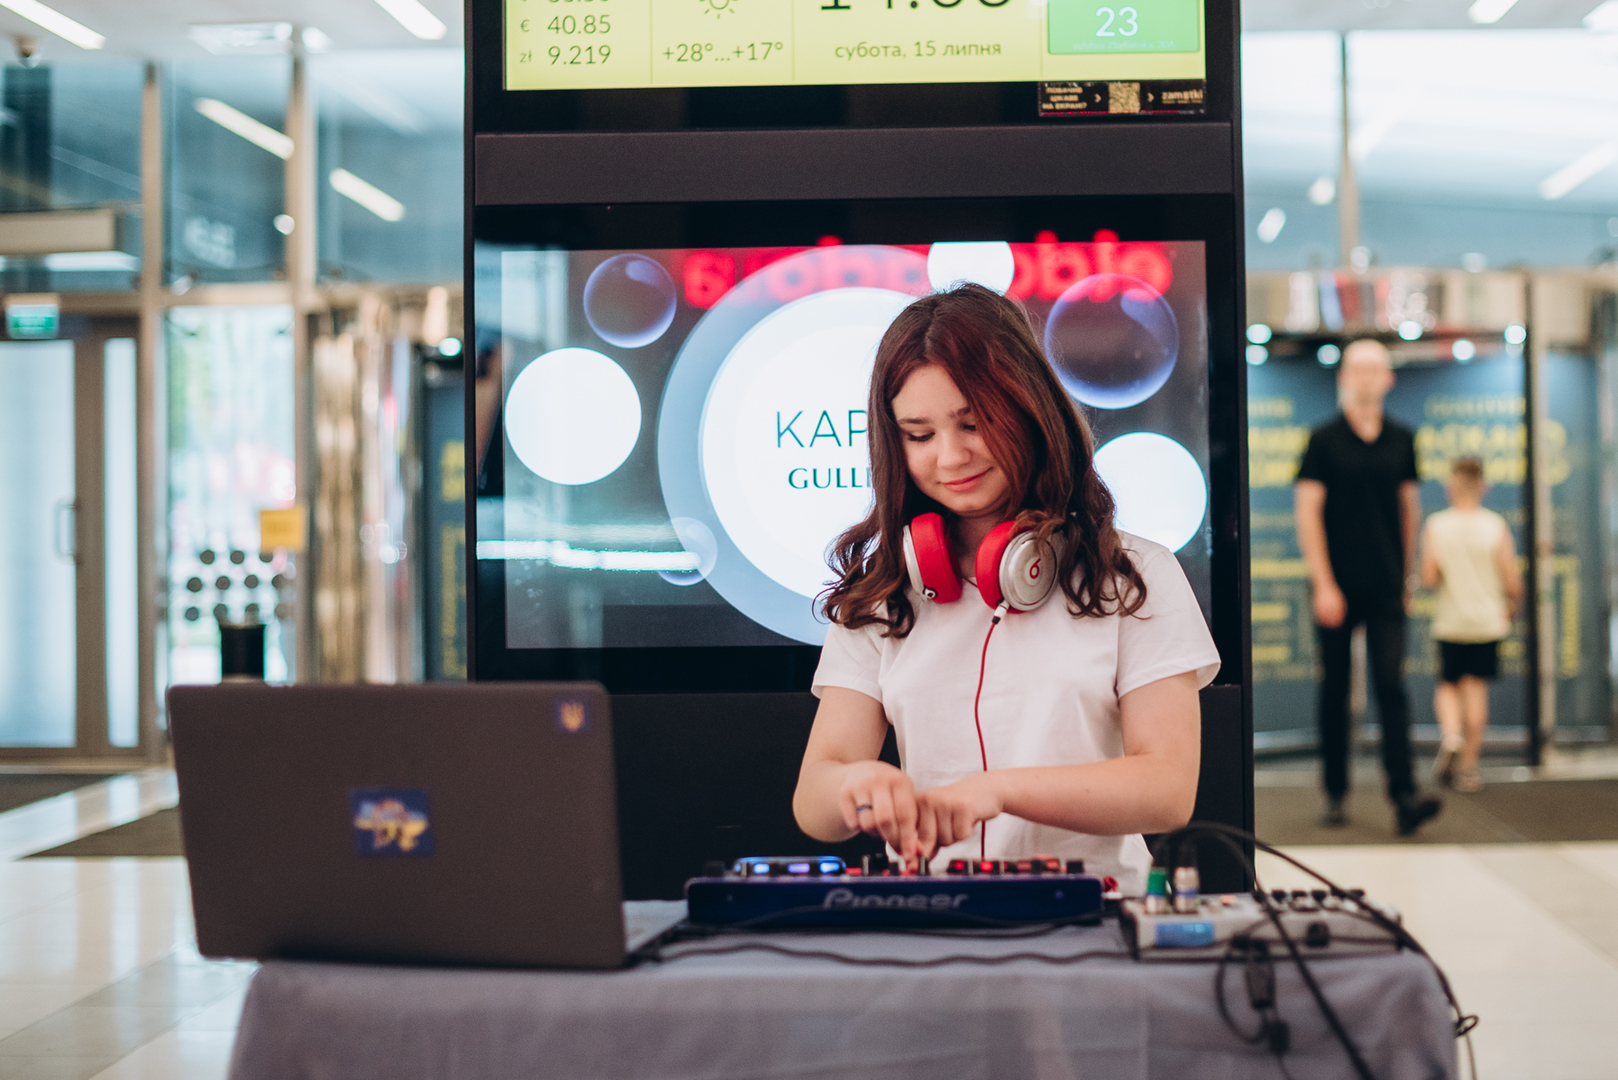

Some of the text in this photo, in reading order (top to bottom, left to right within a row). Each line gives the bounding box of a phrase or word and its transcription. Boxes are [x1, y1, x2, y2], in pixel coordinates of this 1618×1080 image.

[547, 14, 611, 35] 40.85
[1095, 6, 1139, 37] 23
[547, 44, 612, 65] 9.219
[834, 40, 1002, 61] субота, 15 липня
[776, 409, 869, 449] КАР
[787, 467, 872, 490] GULLI
[822, 887, 969, 910] Pioneer
